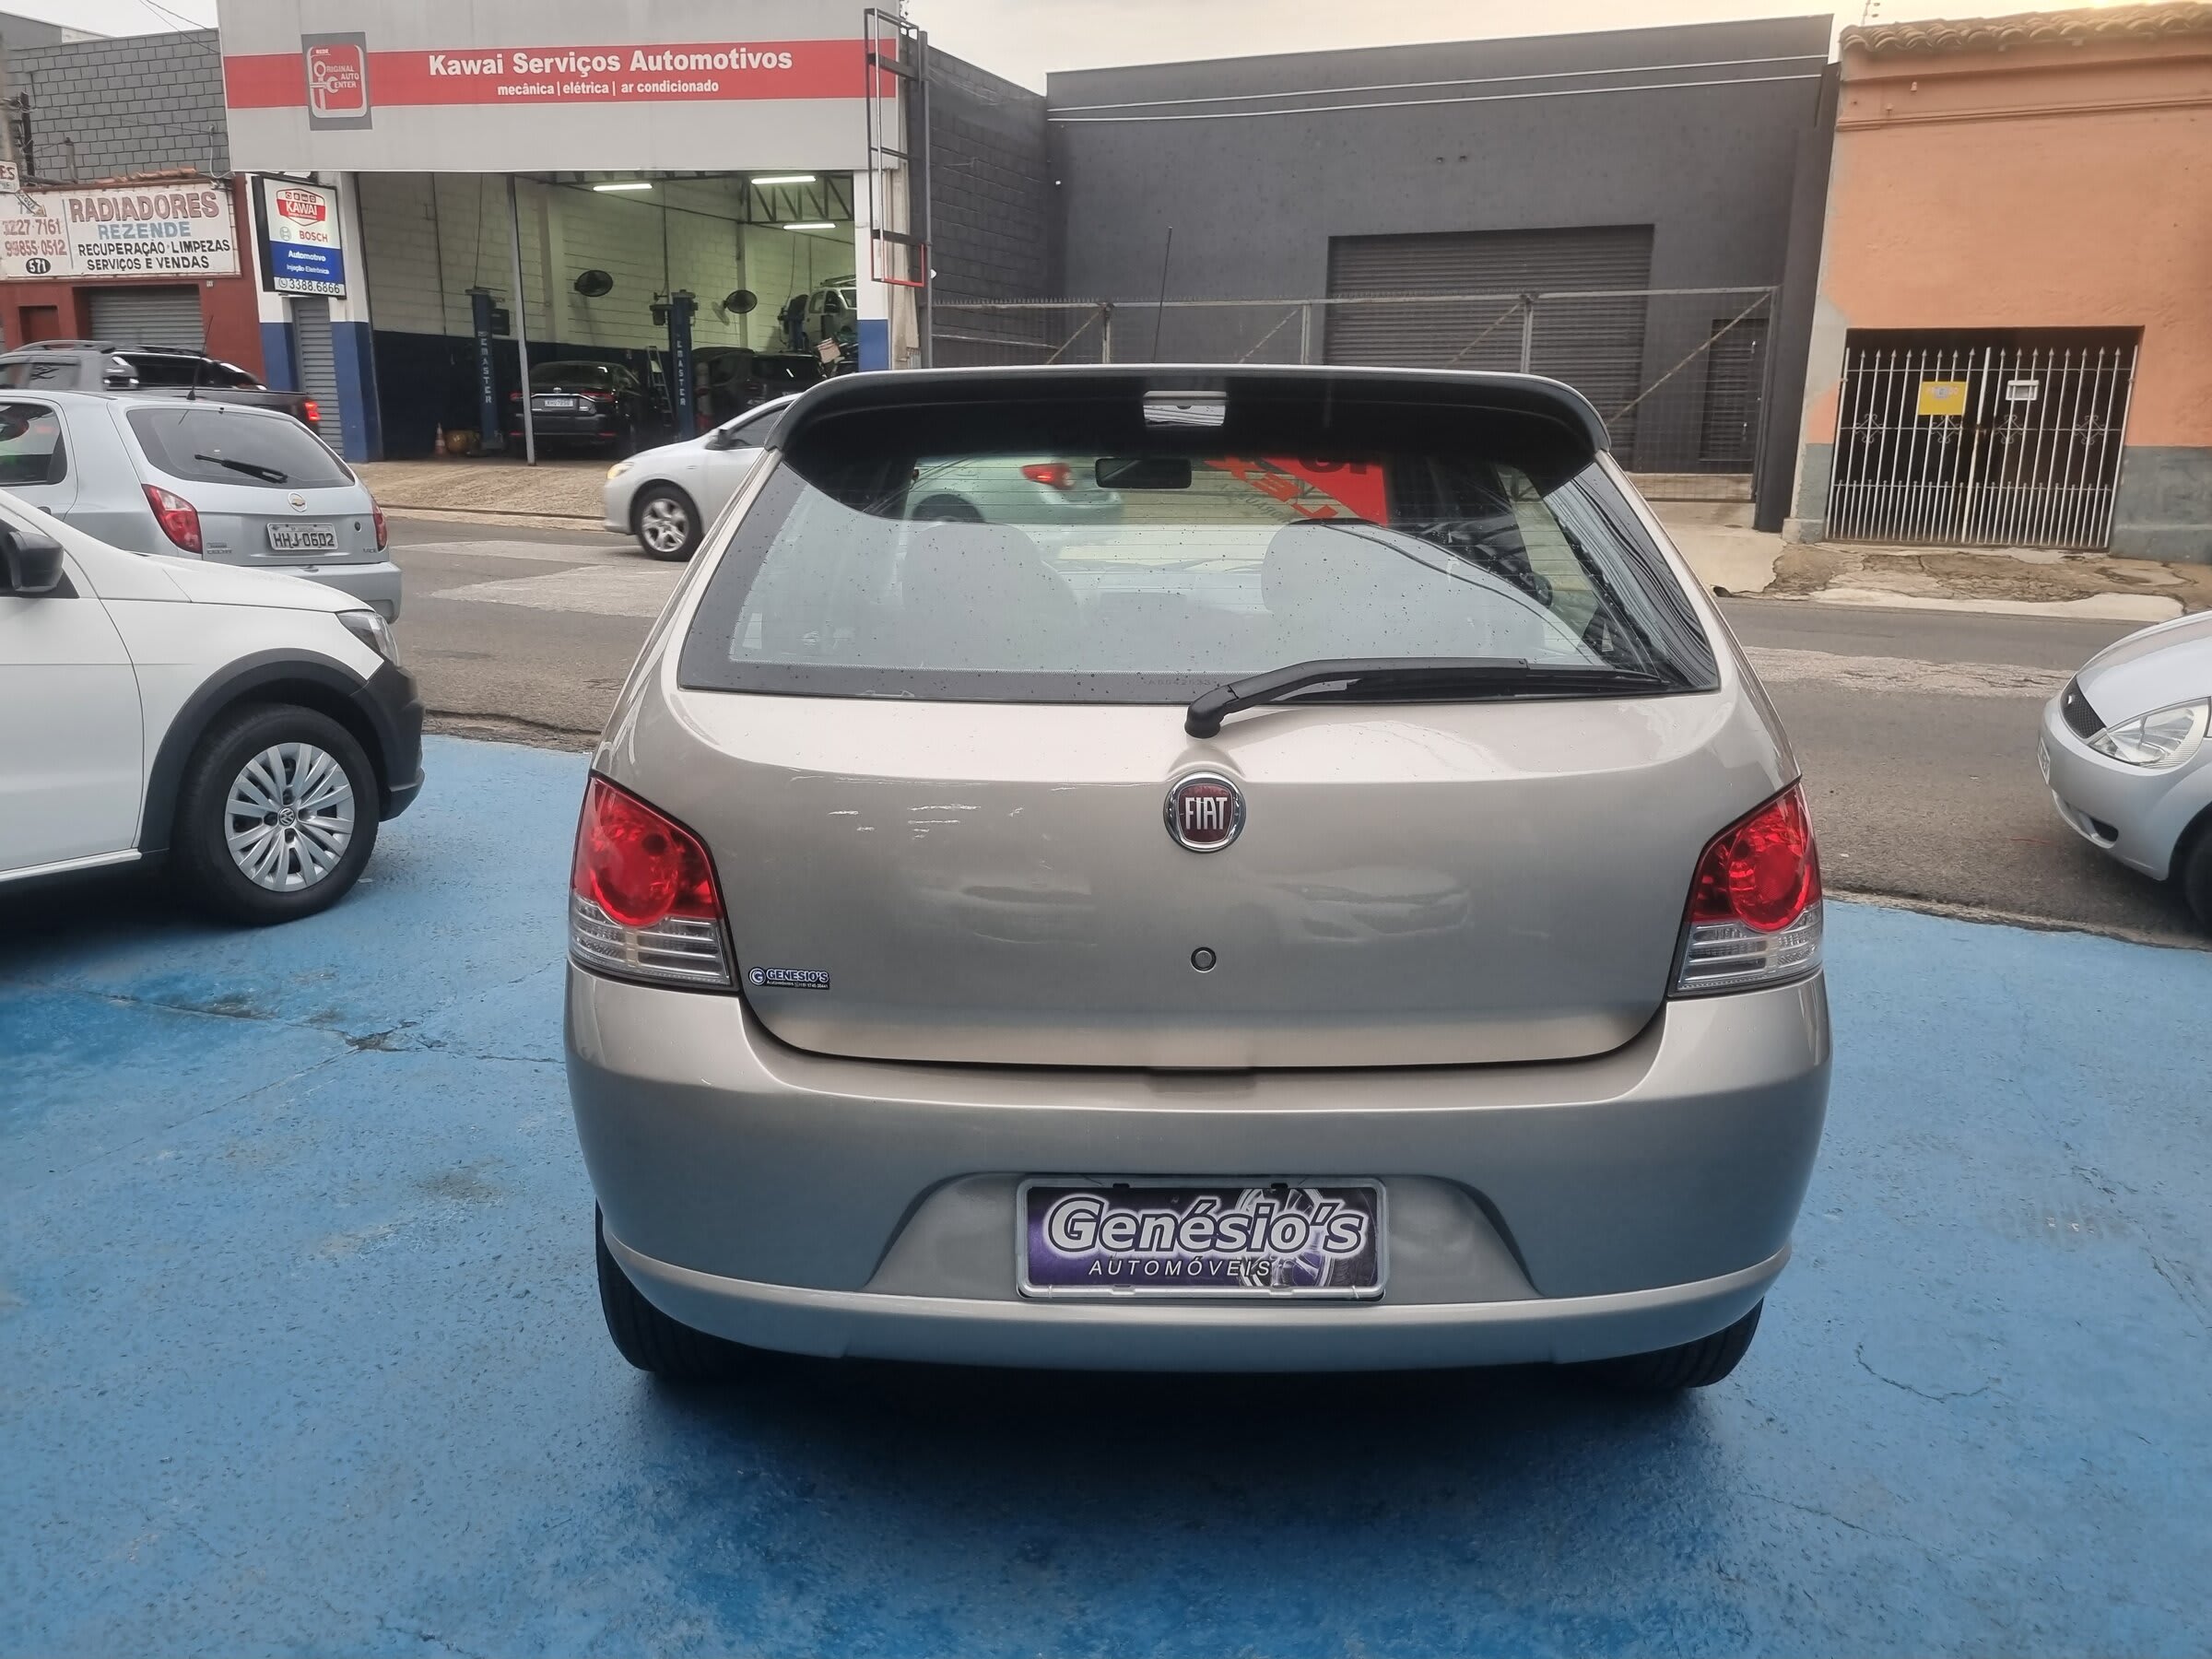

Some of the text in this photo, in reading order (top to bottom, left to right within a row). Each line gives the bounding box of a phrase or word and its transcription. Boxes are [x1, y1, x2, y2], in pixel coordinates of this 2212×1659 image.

[429, 47, 794, 77] Kawai Serviços Automotivos
[340, 73, 360, 81] AUTO
[498, 79, 720, 96] mecânica elétrica ar condicionado
[69, 192, 220, 223] RADIADORES
[286, 200, 318, 216] KAWAI
[97, 221, 192, 241] REZENDE
[299, 230, 329, 242] BOSCH
[77, 239, 230, 257] RECUPERAÇÃO LIMPEZAS
[288, 250, 327, 263] Automotivo
[29, 259, 47, 274] 571
[87, 255, 210, 272] SERVIÇOS E VENDAS
[1184, 796, 1228, 830] FIAT
[766, 968, 830, 983] GENESIO'S
[1047, 1195, 1370, 1255] Genésio's
[1088, 1255, 1273, 1277] AUTOMÓVEIS
